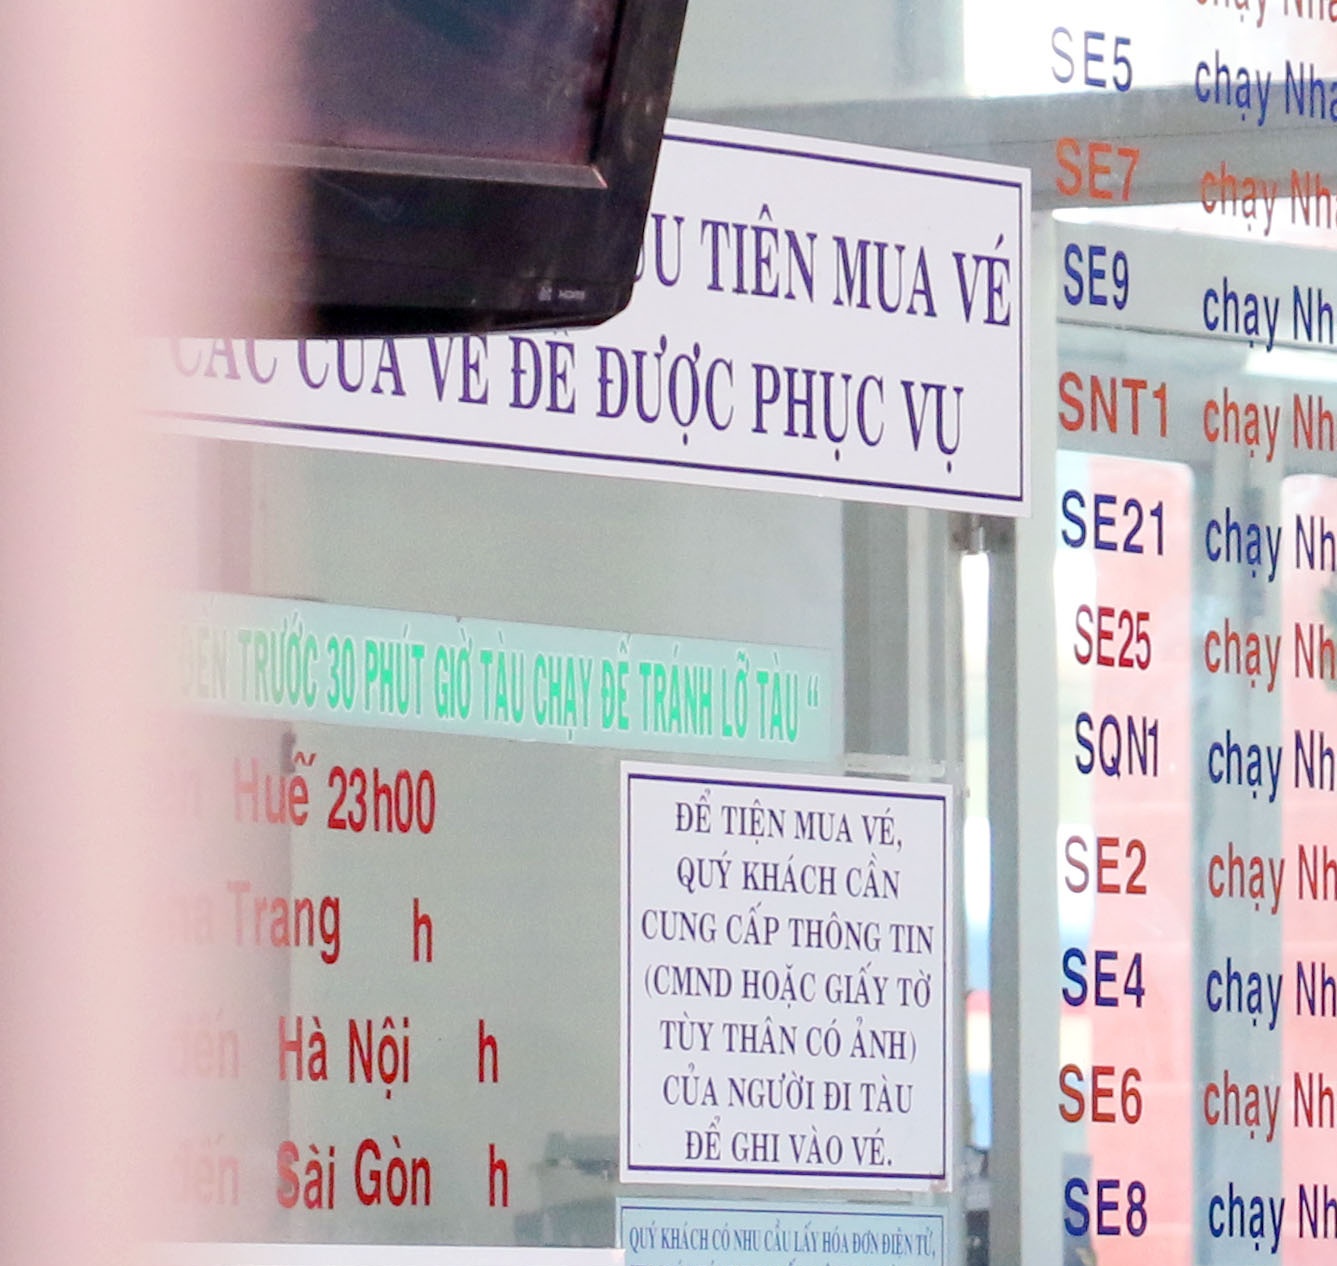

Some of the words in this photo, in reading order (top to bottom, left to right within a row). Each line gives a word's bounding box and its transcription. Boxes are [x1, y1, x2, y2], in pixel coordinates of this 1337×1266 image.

[1050, 27, 1134, 93] SE5
[1195, 57, 1274, 130] chạy
[701, 203, 817, 303] TIÊN
[833, 235, 937, 318] MUA
[953, 233, 1011, 326] VÉ
[597, 335, 734, 446] ĐƯỢC
[751, 362, 885, 462] PHỤC
[900, 379, 964, 473] VỤ
[1060, 491, 1165, 558] SE21
[1205, 507, 1282, 584] chạy
[238, 611, 318, 707] TRƯỚC
[327, 636, 356, 710] 30
[365, 623, 425, 715] PHÚT
[434, 627, 473, 719] GIỜ
[480, 630, 524, 723] TÀU
[534, 652, 592, 740] CHẠY
[639, 644, 712, 735] TRÁNH
[722, 650, 750, 738] LỠ
[756, 651, 798, 742] TÀU
[1075, 713, 1159, 780] SQN1
[1208, 734, 1282, 808] chạy
[327, 764, 436, 834] 23h00
[675, 789, 711, 833] ĐỂ
[721, 799, 786, 844] TIỆN
[794, 810, 853, 843] MUA
[861, 803, 903, 851] VÉ,
[677, 850, 732, 893] QUÝ
[741, 855, 836, 896] KHÁCH
[846, 853, 900, 899] CẦN
[641, 909, 717, 943] CUNG
[726, 902, 780, 946] CẤP
[788, 912, 881, 952] THÔNG
[890, 924, 934, 955] TIN
[645, 963, 732, 999] (CMND
[741, 965, 816, 1009] HOẶC
[825, 962, 889, 1007] GIẤY
[897, 974, 931, 1008] TỜ
[278, 1015, 328, 1082] Hà
[348, 1017, 410, 1100] Nội
[478, 1021, 499, 1084] h
[660, 1011, 714, 1052] TÙY
[722, 1016, 798, 1055] THÂN
[806, 1020, 841, 1057] CÓ
[850, 1016, 917, 1062] ẢNH)
[663, 1063, 719, 1107] CỦA
[728, 1070, 816, 1111] NGƯỜI
[823, 1080, 852, 1112] ĐI
[860, 1073, 913, 1114] TÀU
[277, 1134, 336, 1210] Sài
[354, 1135, 432, 1209] Gòn
[488, 1144, 510, 1207] h
[685, 1115, 721, 1161] ĐỂ
[732, 1130, 779, 1163] GHI
[789, 1125, 844, 1166] VÀO
[852, 1128, 893, 1167] VÉ.
[1063, 1177, 1147, 1238] SE8
[1208, 1186, 1285, 1262] chạy
